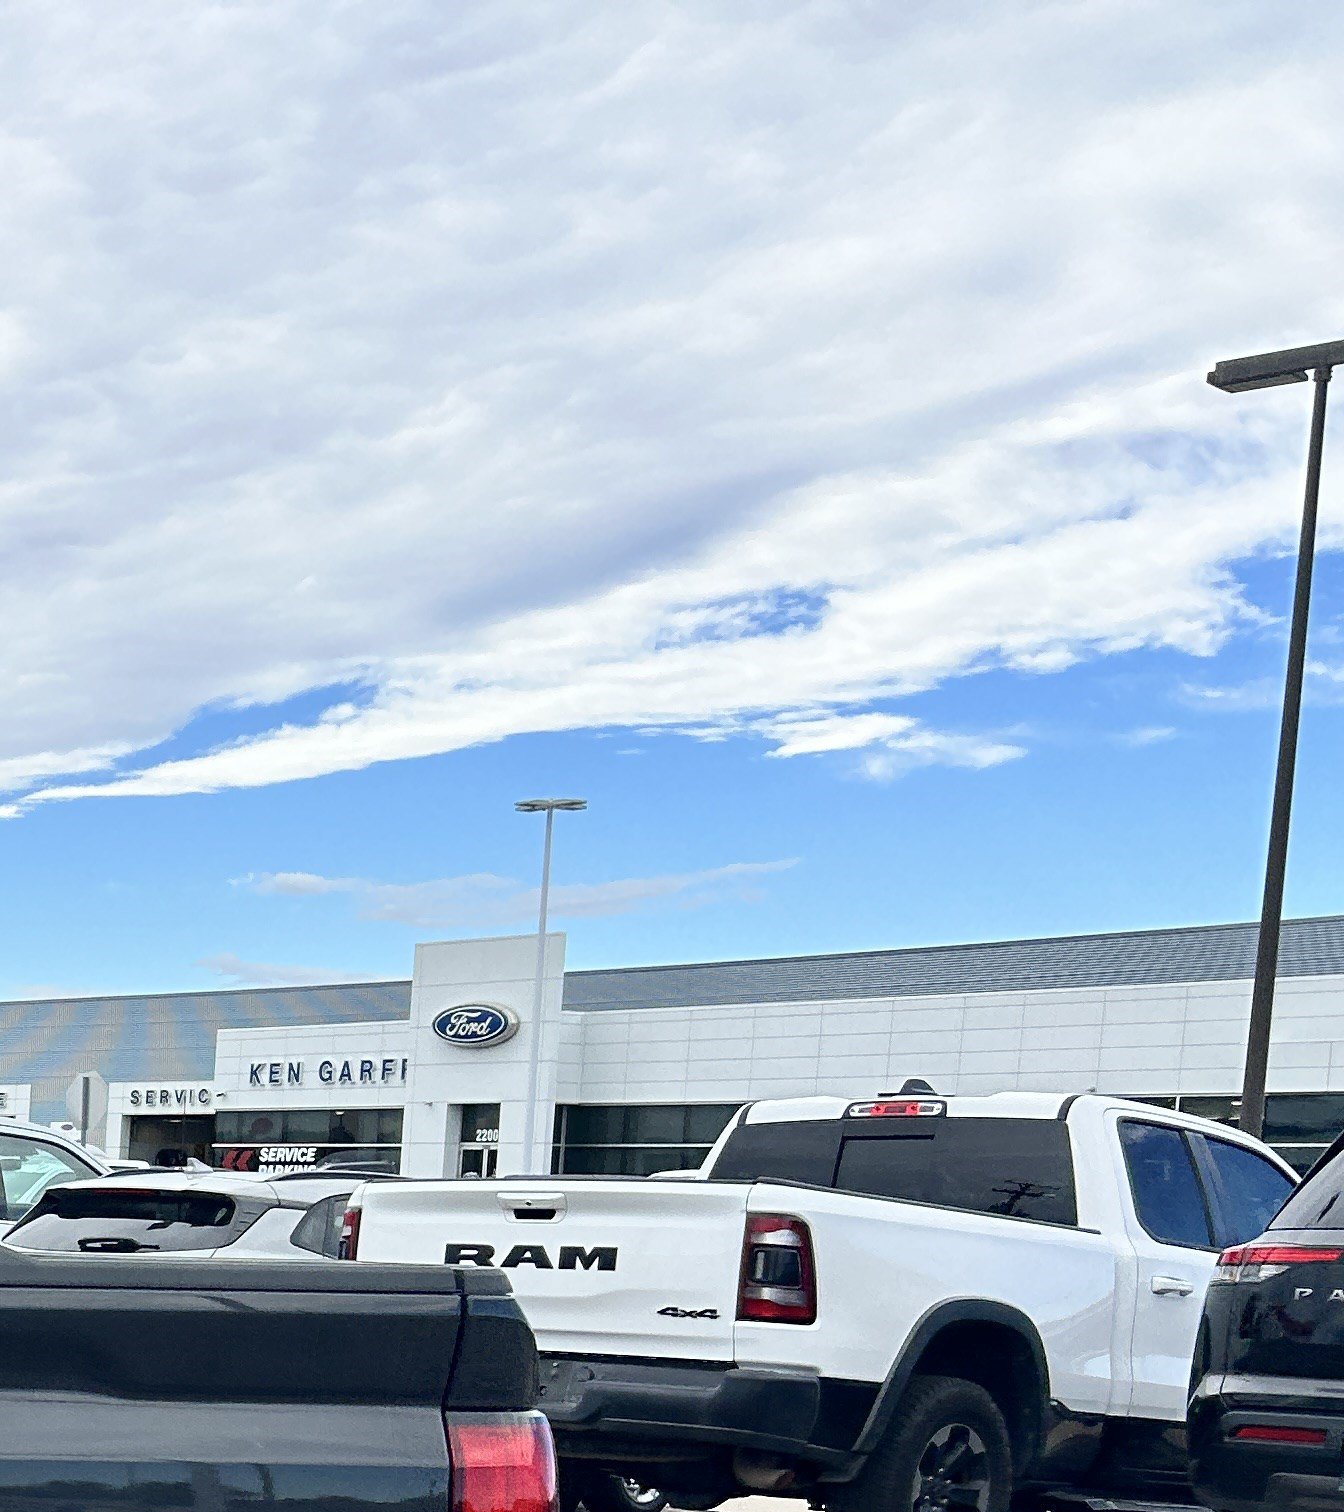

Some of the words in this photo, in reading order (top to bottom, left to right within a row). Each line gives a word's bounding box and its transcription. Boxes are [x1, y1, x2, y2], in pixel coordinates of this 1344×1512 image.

[445, 1011, 492, 1036] Ford
[249, 1062, 301, 1084] KEN
[129, 1087, 225, 1106] SERVIC
[475, 1128, 499, 1142] 2200
[258, 1147, 318, 1162] SERVICE
[444, 1243, 618, 1271] RAM
